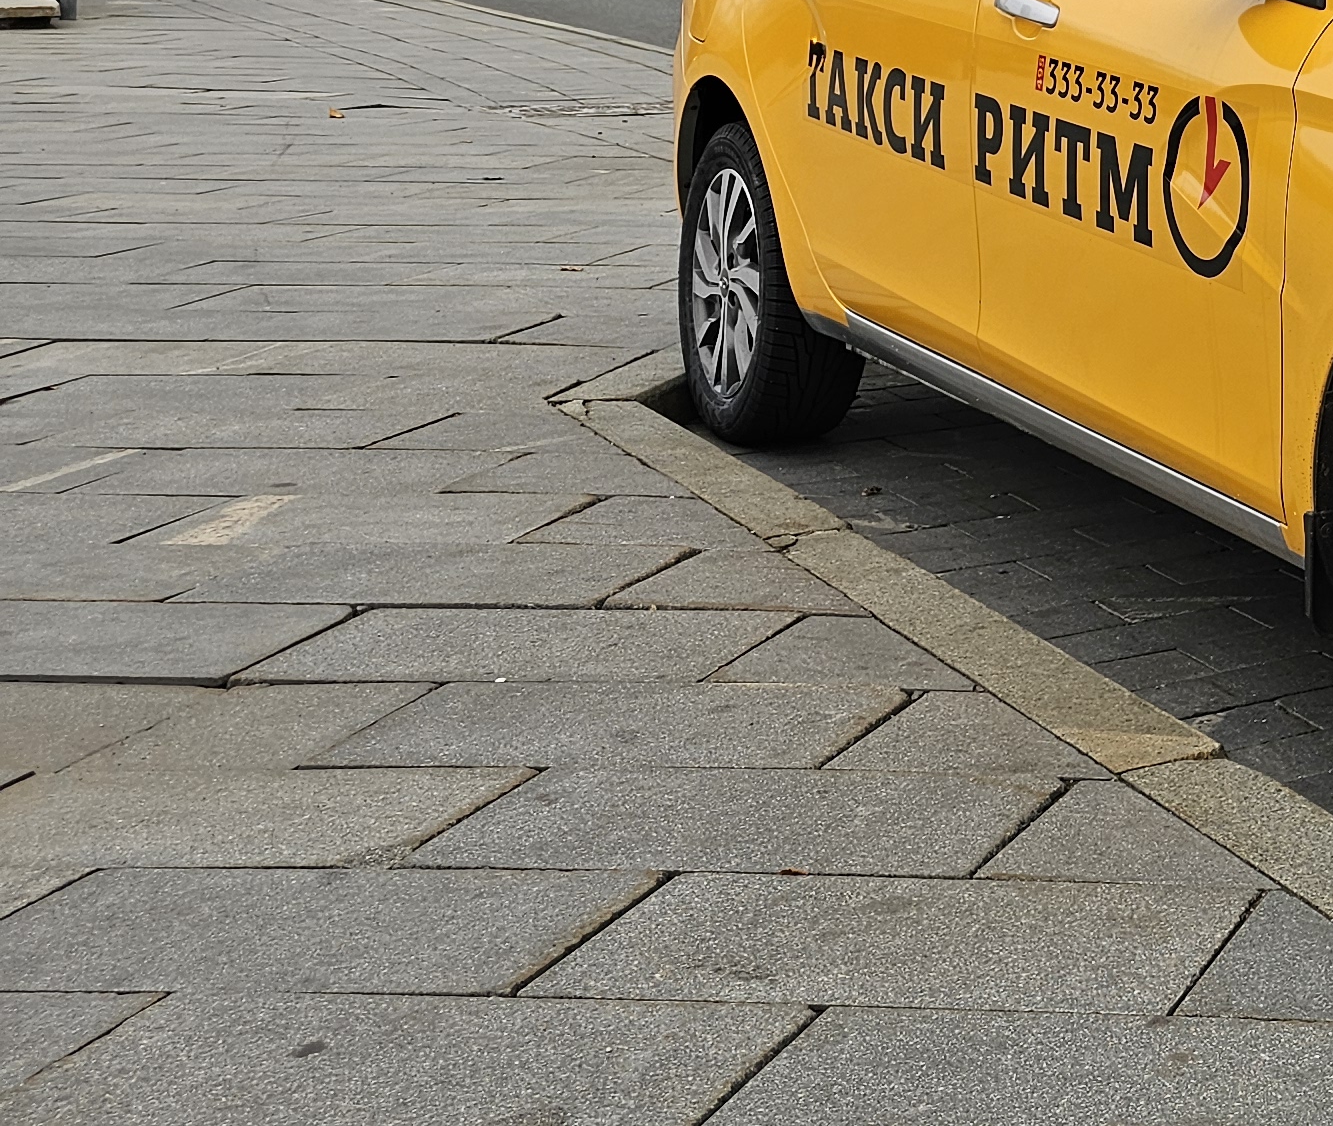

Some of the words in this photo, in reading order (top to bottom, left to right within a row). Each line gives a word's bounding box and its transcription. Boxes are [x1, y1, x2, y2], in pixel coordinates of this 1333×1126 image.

[807, 39, 946, 171] ТАКСИ
[973, 93, 1155, 249] РИТМ
[1045, 58, 1160, 125] 333-33-33
